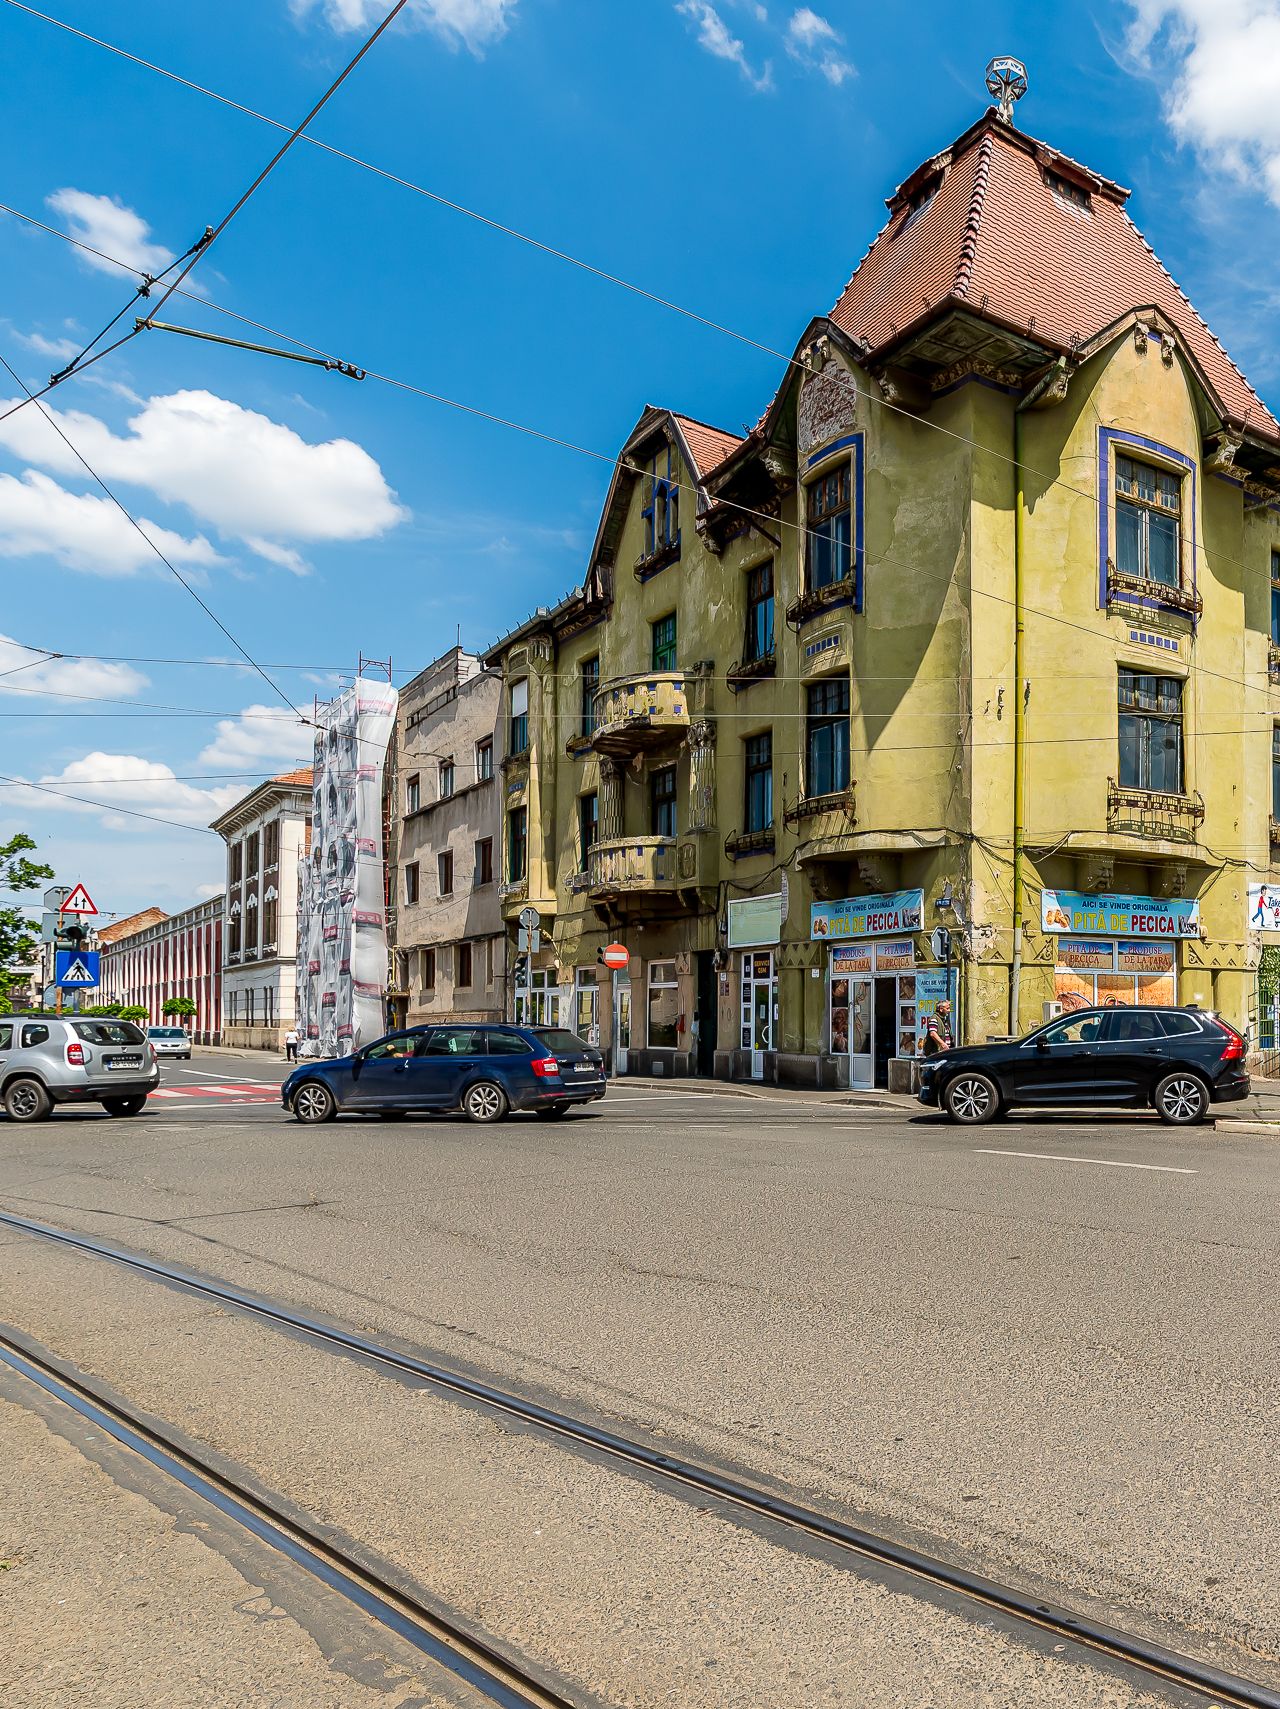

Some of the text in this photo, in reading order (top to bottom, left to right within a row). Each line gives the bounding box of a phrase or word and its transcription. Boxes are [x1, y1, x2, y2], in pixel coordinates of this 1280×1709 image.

[852, 904, 867, 912] VINDE
[1110, 902, 1131, 910] VINDE
[1132, 903, 1169, 912] ORIGINALA
[852, 916, 865, 933] DE
[866, 912, 899, 932] PECICA
[1110, 914, 1129, 931] DE
[1131, 914, 1175, 933] PECICA
[900, 944, 909, 954] DE
[1088, 945, 1099, 953] DE
[1128, 946, 1163, 954] PRODUSE
[885, 957, 910, 968] PECICA
[1070, 955, 1100, 964] PECICA
[1124, 956, 1135, 964] DE
[1136, 956, 1148, 964] LA
[836, 961, 844, 970] DE
